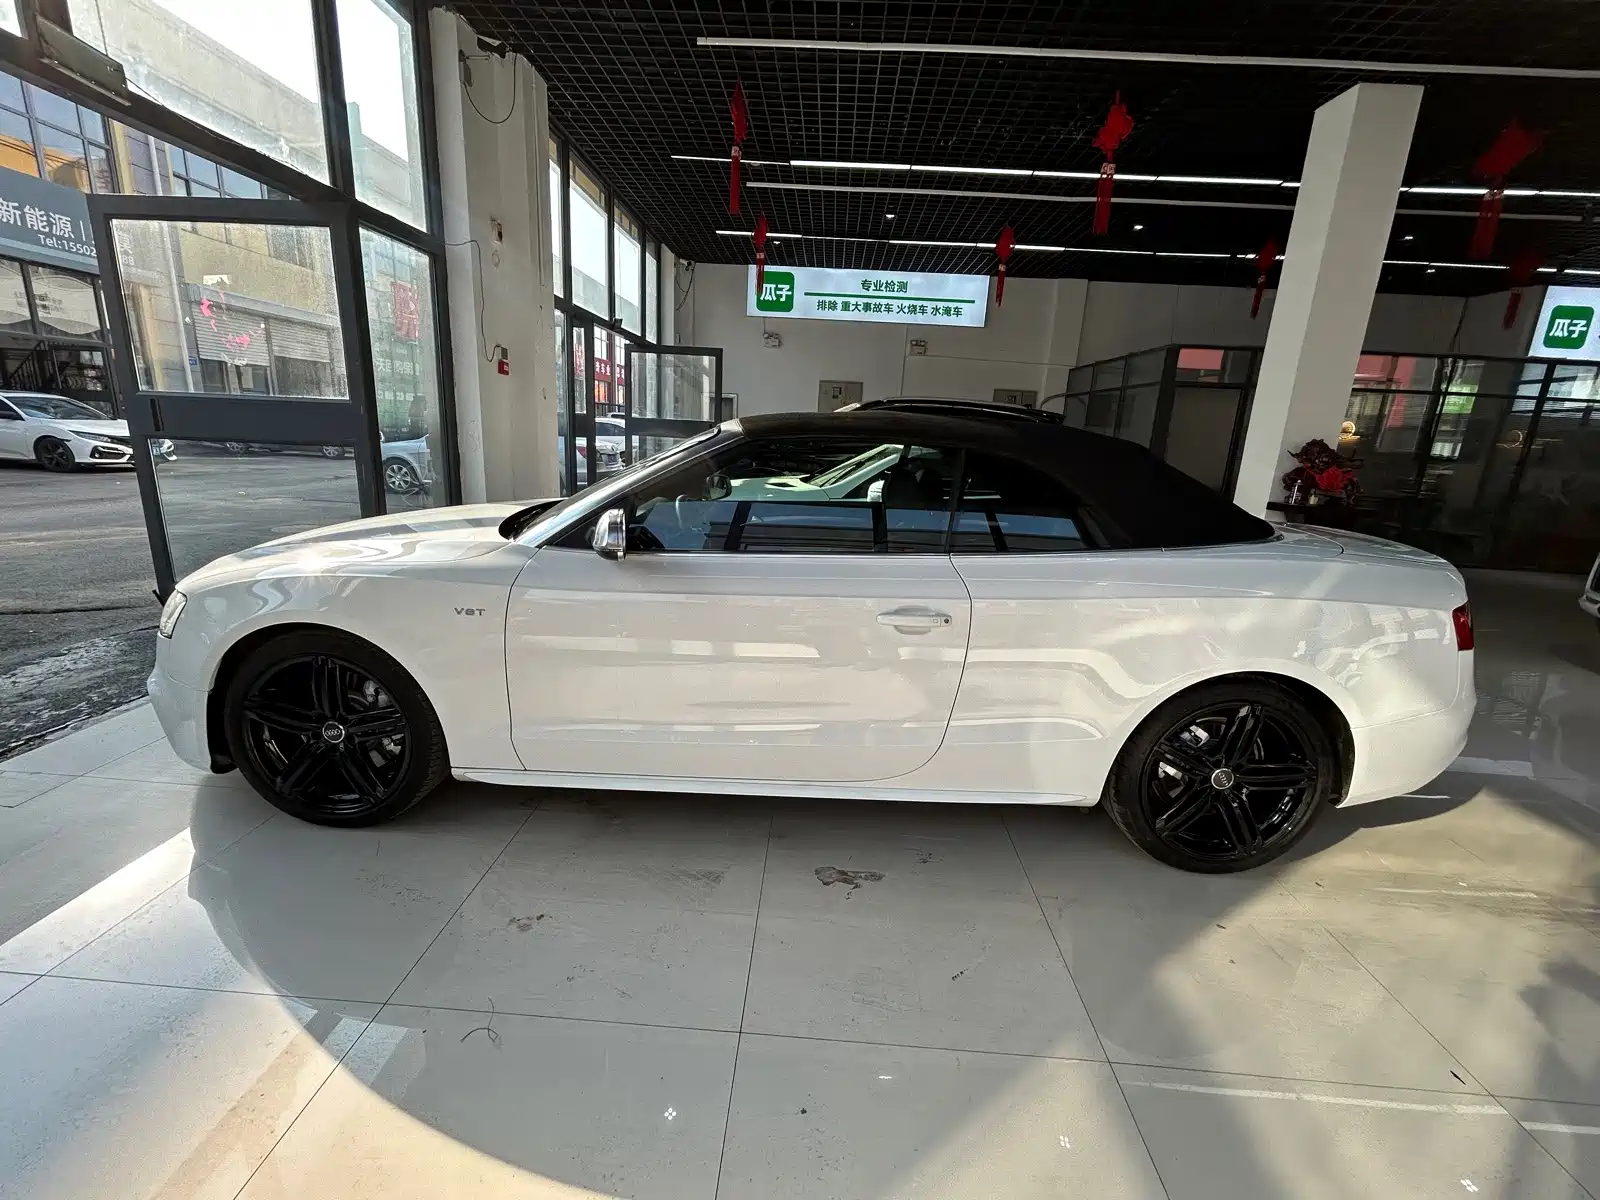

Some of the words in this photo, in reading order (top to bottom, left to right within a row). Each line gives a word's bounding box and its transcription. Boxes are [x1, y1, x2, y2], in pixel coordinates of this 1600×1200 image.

[760, 283, 792, 302] 瓜子
[860, 278, 909, 294] 专业检测
[816, 299, 838, 312] 排除
[840, 301, 894, 314] 重大事故车
[896, 304, 928, 316] 火烧车
[930, 305, 963, 318] 水淹车
[1549, 318, 1588, 338] 瓜子
